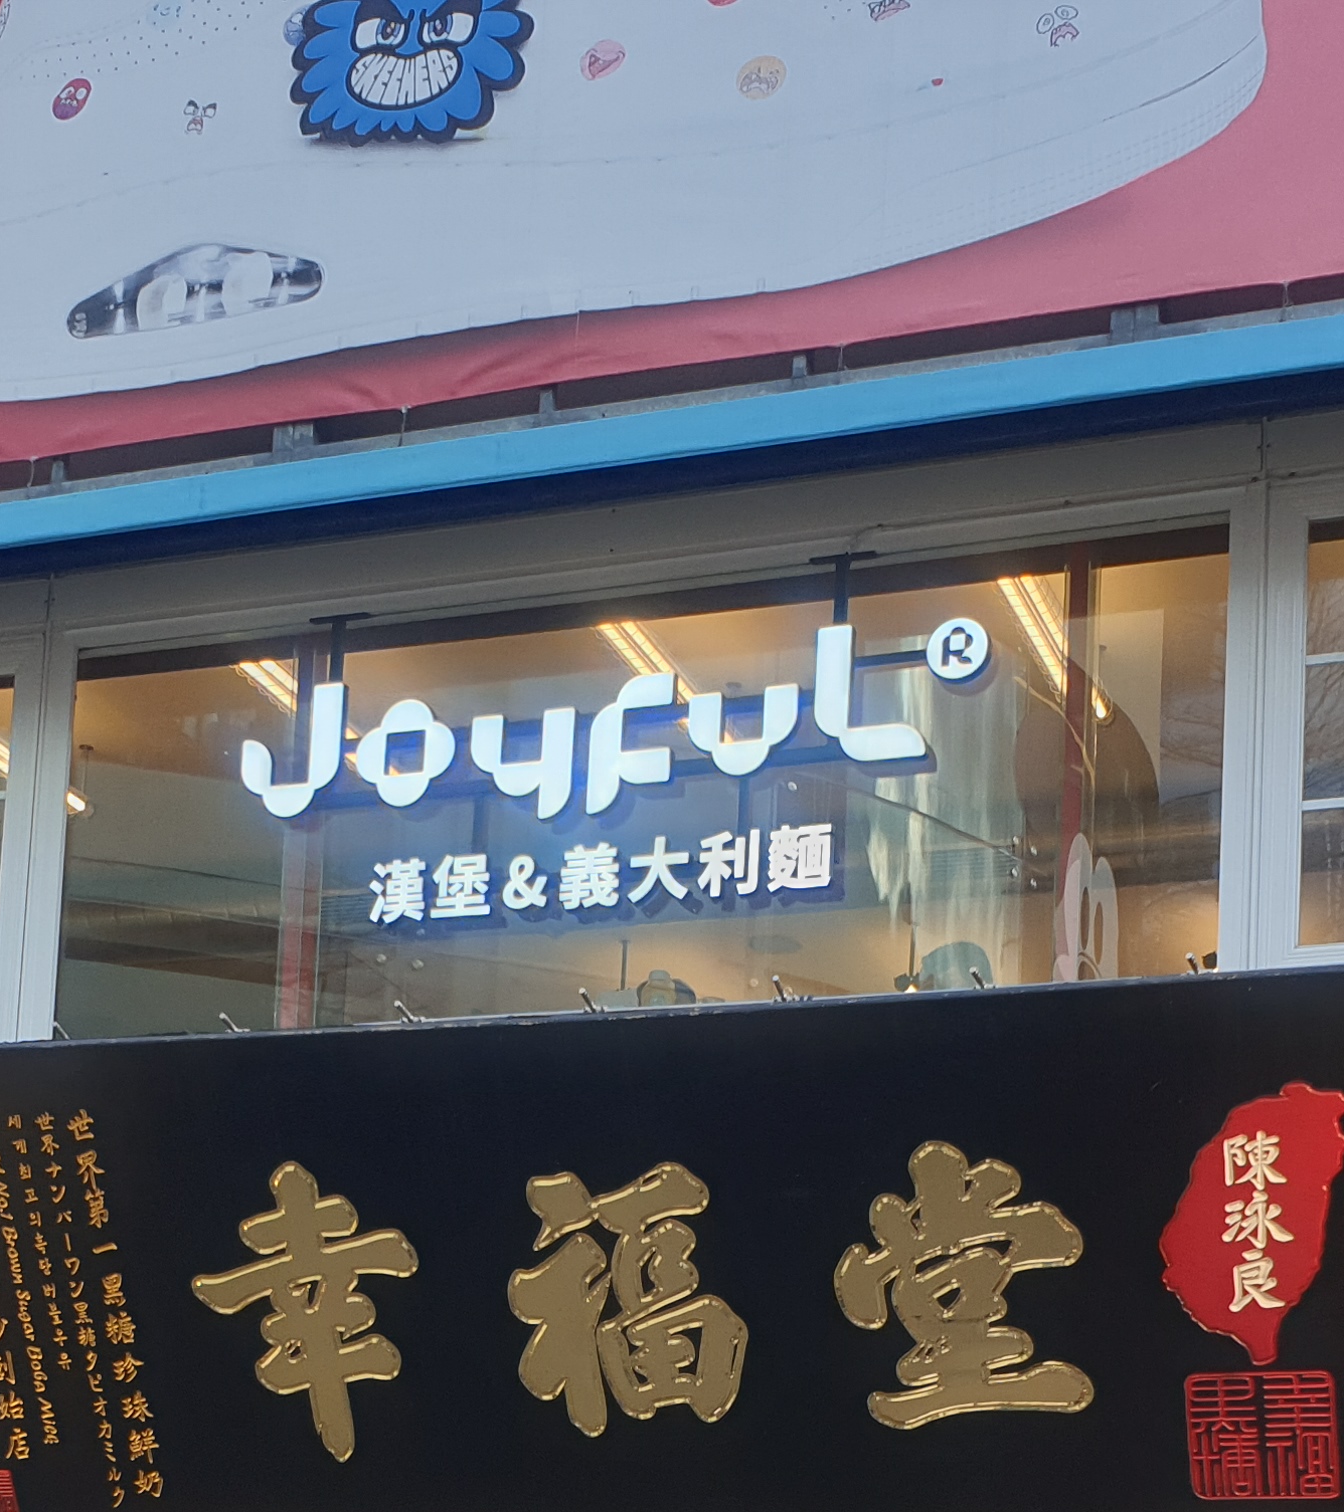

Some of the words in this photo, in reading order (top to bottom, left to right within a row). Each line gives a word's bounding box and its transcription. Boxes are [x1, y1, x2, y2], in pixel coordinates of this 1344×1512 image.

[1, 1225, 23, 1285] Brown
[16, 1288, 36, 1342] Sugar
[26, 1345, 48, 1393] Boba
[67, 1108, 164, 1498] 世界第一黑糖珍珠鮮奶
[191, 1140, 1095, 1462] 幸福堂
[1221, 1130, 1296, 1313] 陳泳良
